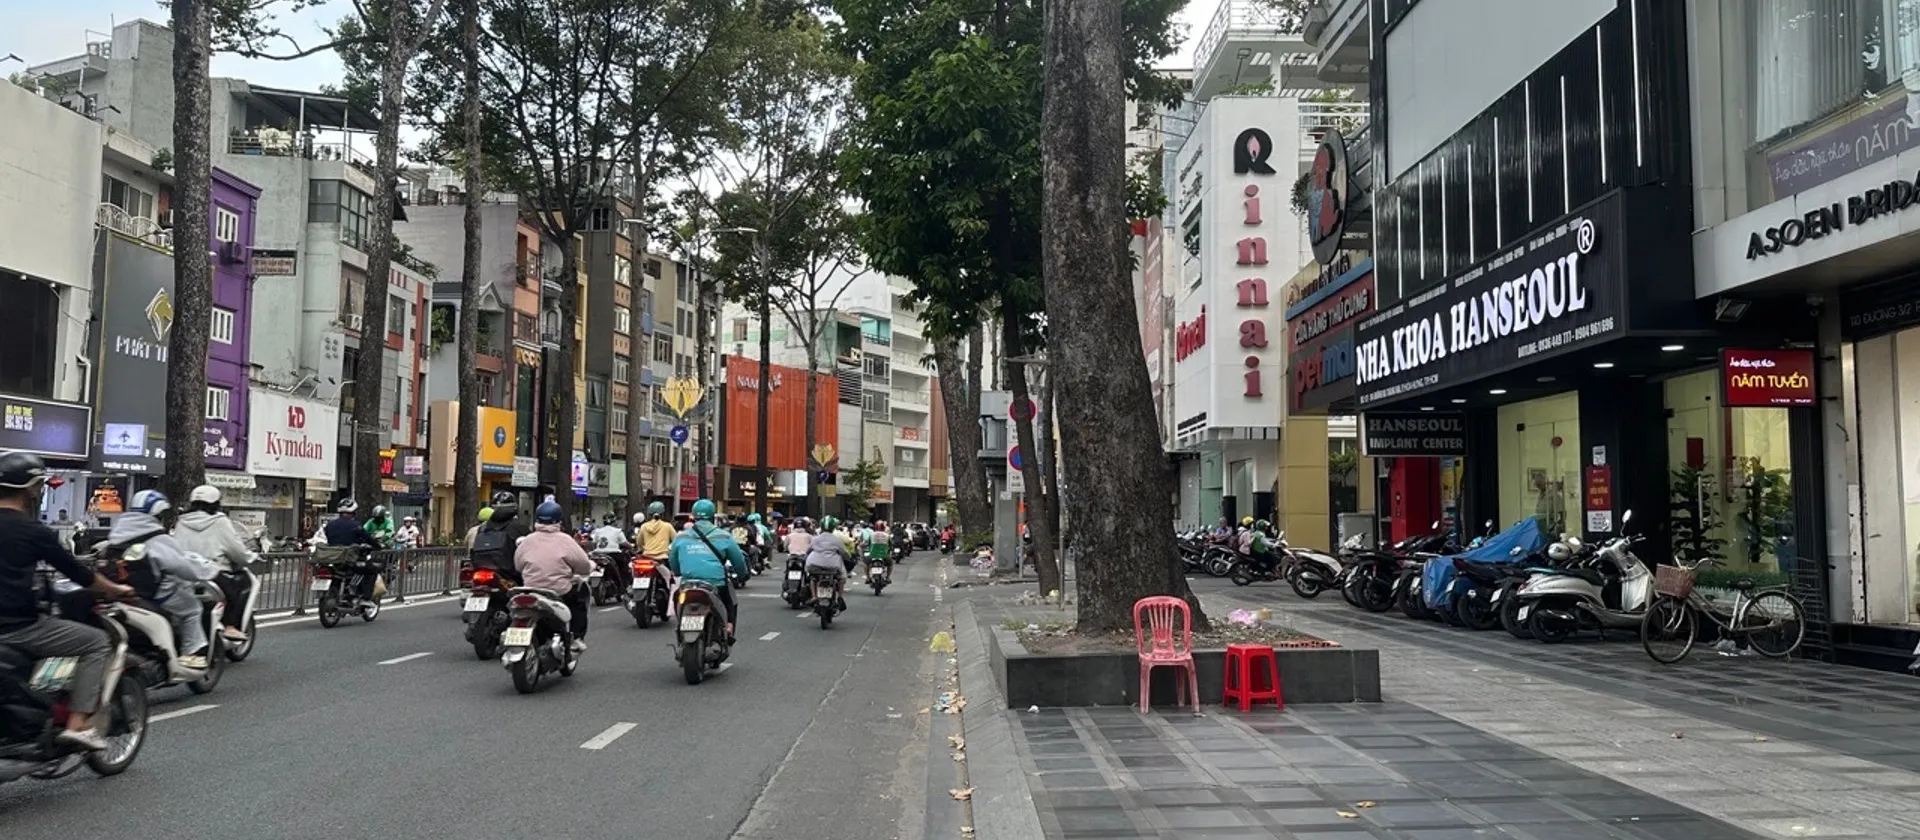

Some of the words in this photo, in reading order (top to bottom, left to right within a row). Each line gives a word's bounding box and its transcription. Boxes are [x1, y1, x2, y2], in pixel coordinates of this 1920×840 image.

[1746, 202, 1842, 260] ASOEN
[1233, 128, 1277, 398] Rinnai
[1356, 335, 1391, 385] NHA
[1392, 312, 1446, 371] KHOA
[1450, 252, 1586, 354] HANSEOUL
[265, 431, 323, 461] Kymdan
[1369, 419, 1463, 432] HANSEOUL
[1369, 437, 1419, 449] IMPLANT
[1422, 437, 1464, 449] CENTER
